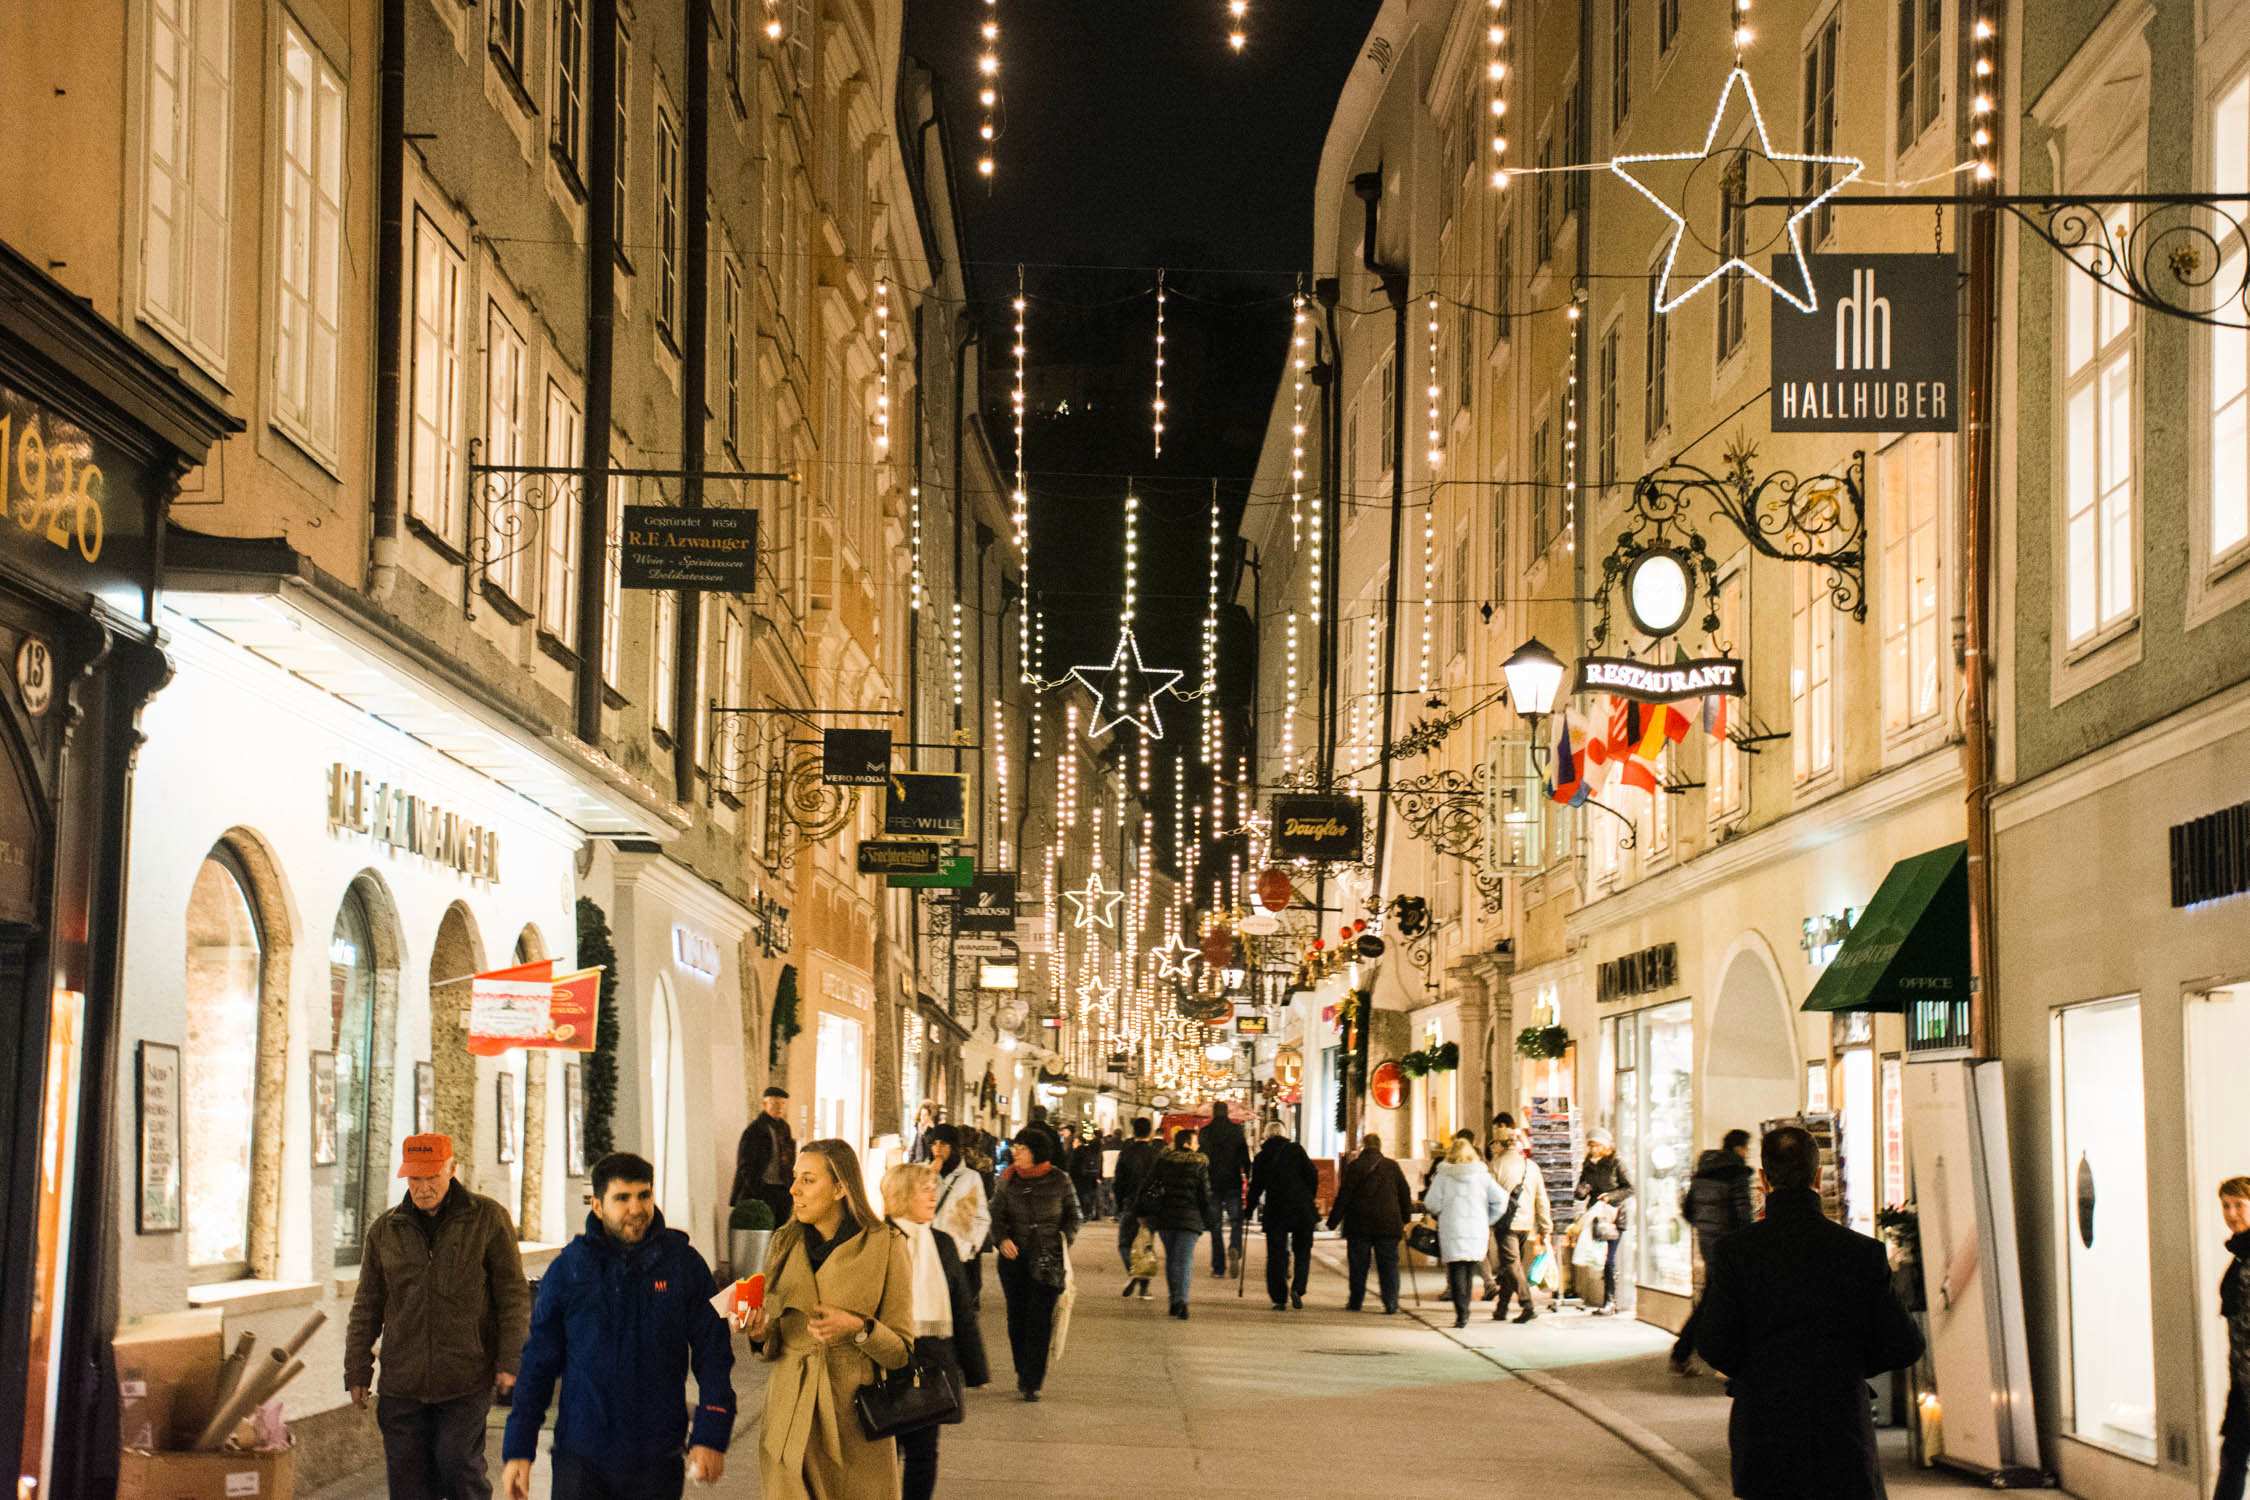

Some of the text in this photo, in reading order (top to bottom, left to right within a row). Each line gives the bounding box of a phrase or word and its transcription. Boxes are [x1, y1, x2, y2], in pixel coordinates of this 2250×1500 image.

[1782, 382, 1947, 418] HALLHUBER
[664, 532, 749, 552] Azwanger
[26, 642, 45, 689] 13
[1586, 664, 1736, 693] RESTAURANT
[825, 774, 886, 784] VERO MODA
[1284, 817, 1348, 841] Douglas
[1900, 977, 1953, 990] OFFICE
